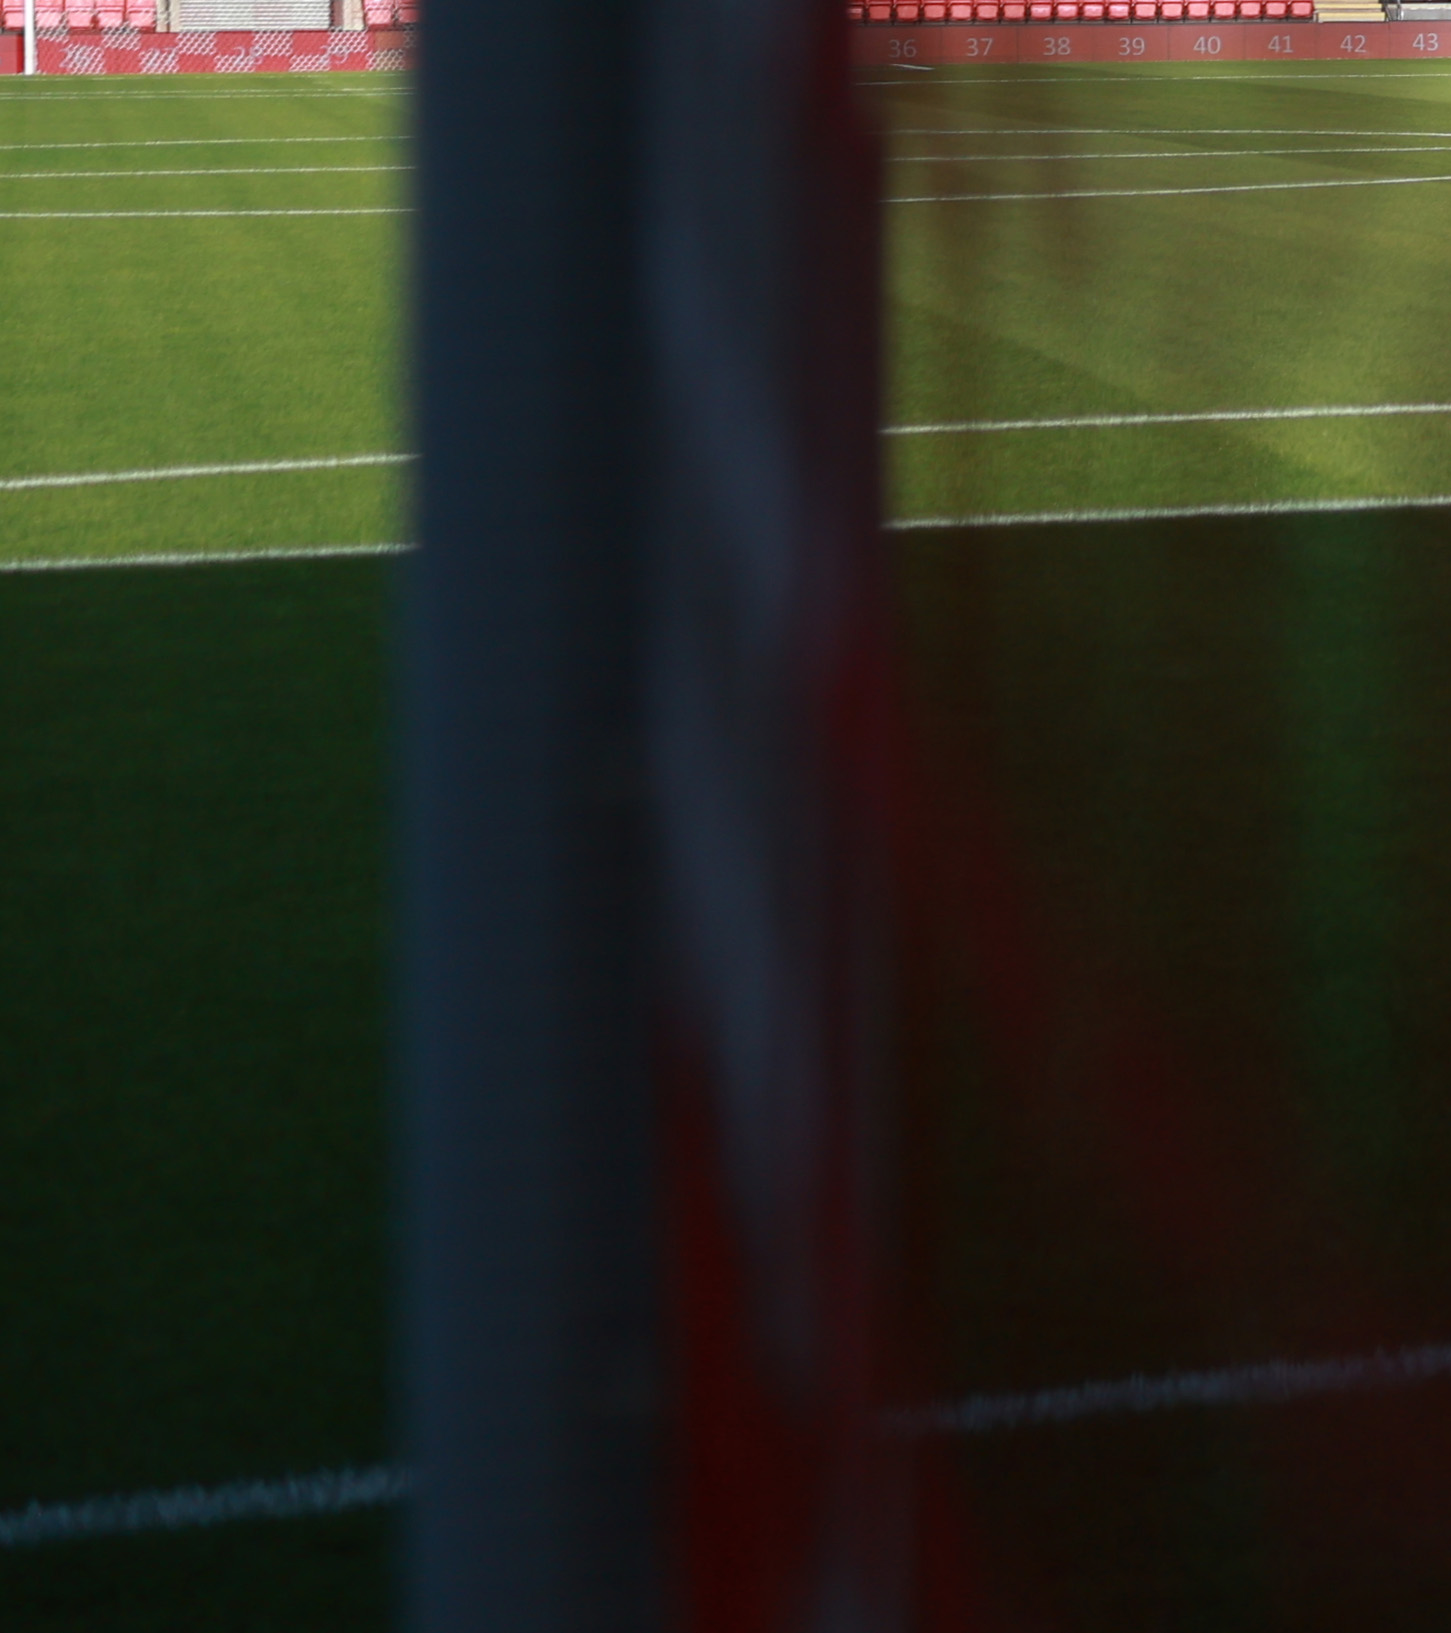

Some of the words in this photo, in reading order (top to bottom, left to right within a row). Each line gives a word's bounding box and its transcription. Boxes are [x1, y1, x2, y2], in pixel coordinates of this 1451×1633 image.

[889, 39, 917, 57] 36
[967, 38, 992, 56] 37
[1044, 37, 1070, 55] 38
[1120, 37, 1144, 55] 39
[1194, 36, 1220, 54] 40
[1268, 35, 1293, 53] 41
[1340, 35, 1366, 52] 42
[1413, 33, 1438, 50] 43
